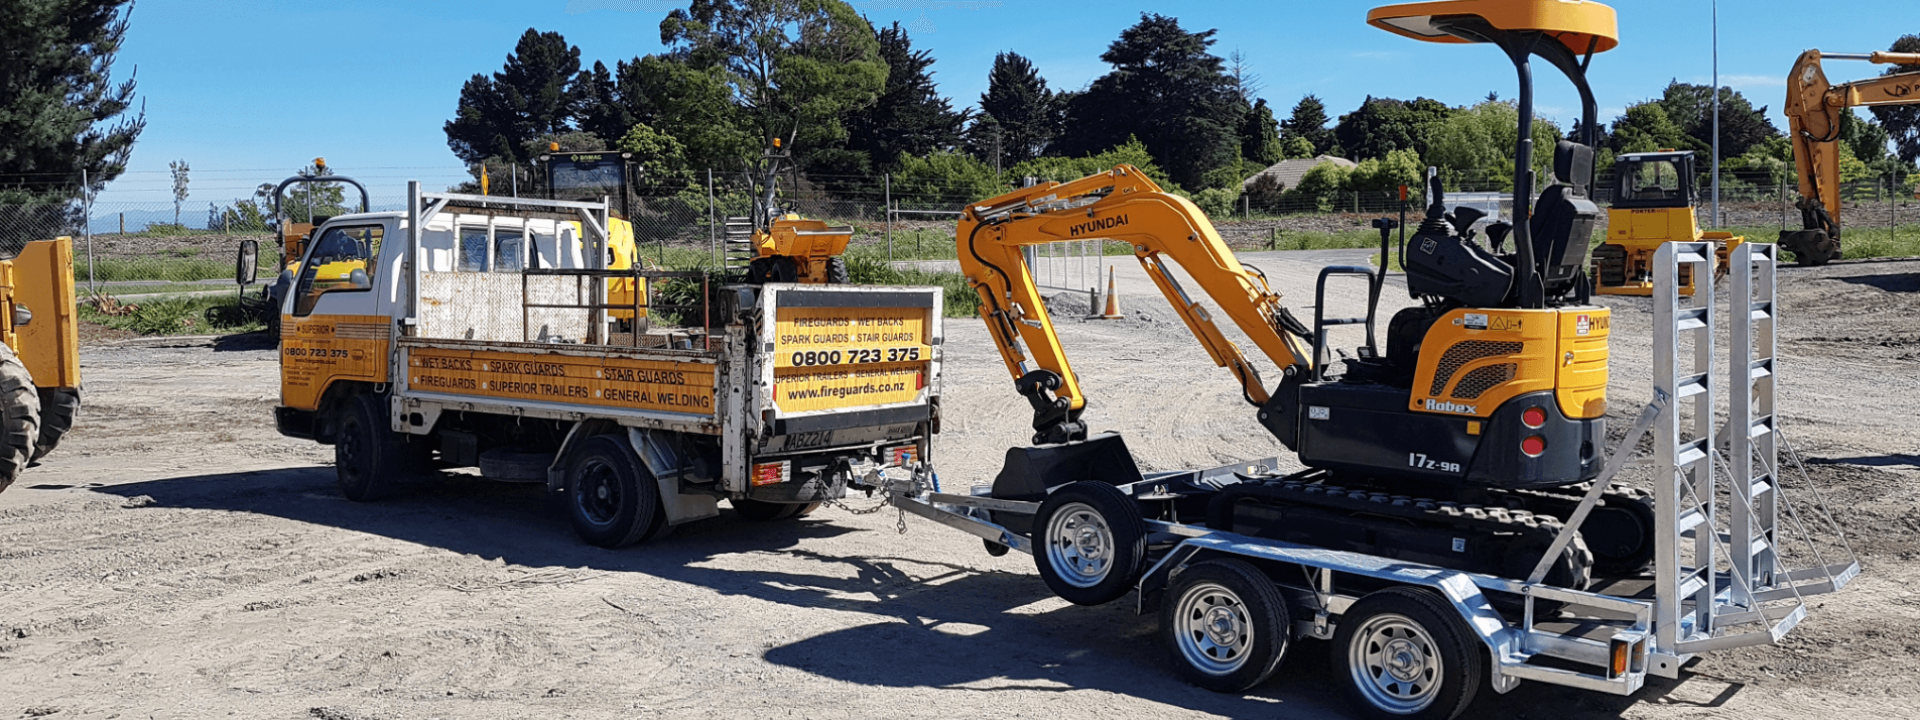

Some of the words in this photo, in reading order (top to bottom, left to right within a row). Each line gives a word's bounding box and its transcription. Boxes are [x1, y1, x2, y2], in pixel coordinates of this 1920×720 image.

[1070, 214, 1128, 236] HYUNDAI
[302, 325, 330, 334] SUPERIOR
[794, 317, 850, 327] FIREGUARDS
[858, 317, 876, 326] WET
[877, 316, 904, 326] BACKS
[781, 334, 810, 345] SPARK
[813, 333, 849, 344] GUARDS
[857, 333, 880, 342] STAIR
[882, 332, 914, 342] GUARDS
[284, 347, 307, 357] 0800
[309, 348, 327, 357] 723
[330, 349, 348, 358] 375
[792, 350, 842, 367] 0800
[847, 348, 882, 364] 723
[887, 347, 919, 362] 375
[421, 357, 441, 368] WET
[442, 358, 473, 371] BACKS
[490, 361, 521, 373] SPARK
[523, 362, 565, 377] GUARDS
[420, 374, 477, 390] FIREGUARDS
[604, 367, 635, 382] STAIR
[637, 370, 685, 385] GUARDS
[773, 373, 811, 384] UPERIOR
[812, 370, 849, 381] TRAILERS
[855, 368, 889, 378] GENERAL
[489, 380, 538, 395] SUPERIOR
[539, 383, 589, 399] TRAILERS
[603, 387, 655, 404] GENERAL
[656, 392, 710, 408] WELDING
[788, 382, 904, 399] www.fireguards.co.nz
[1425, 398, 1477, 414] Robex
